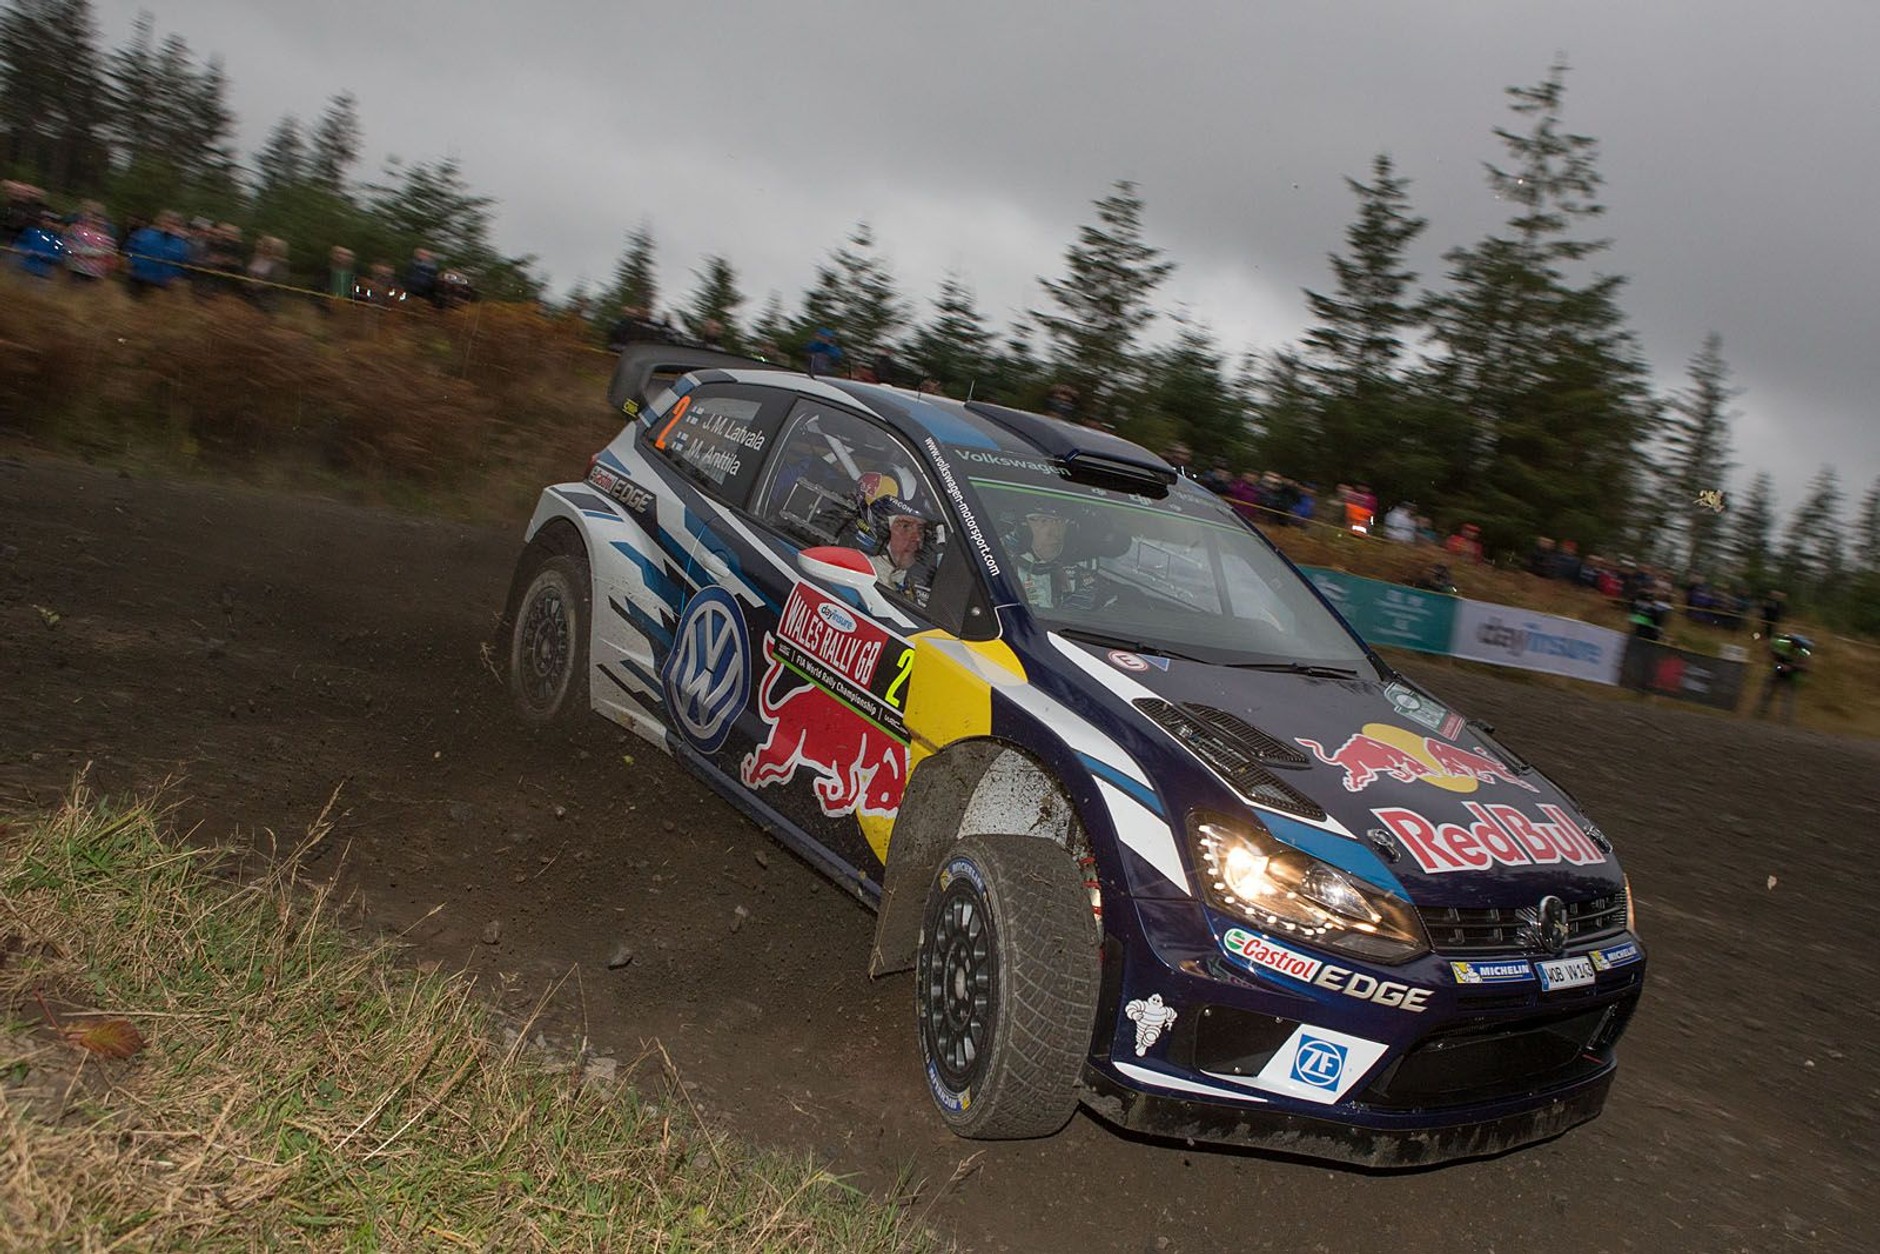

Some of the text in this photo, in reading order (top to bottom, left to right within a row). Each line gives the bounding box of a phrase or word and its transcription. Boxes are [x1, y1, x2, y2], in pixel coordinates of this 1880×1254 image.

[655, 395, 691, 449] 2
[724, 420, 766, 451] Latvala
[687, 438, 741, 476] M. Anttila
[955, 449, 1073, 477] Volkswagen
[611, 479, 655, 514] EDGE
[925, 437, 1000, 577] www.volkswagen-motorsport.com
[821, 605, 853, 630] dayinsure
[784, 591, 881, 685] WALES RALLY GB
[822, 672, 836, 689] Rally
[836, 682, 877, 716] Championship
[885, 648, 916, 708] 2
[1479, 964, 1529, 976] MICHELIN
[1606, 945, 1637, 961] MICHELIN
[1242, 938, 1435, 1013] Castrol EDGE
[1299, 1046, 1340, 1081] ZF
